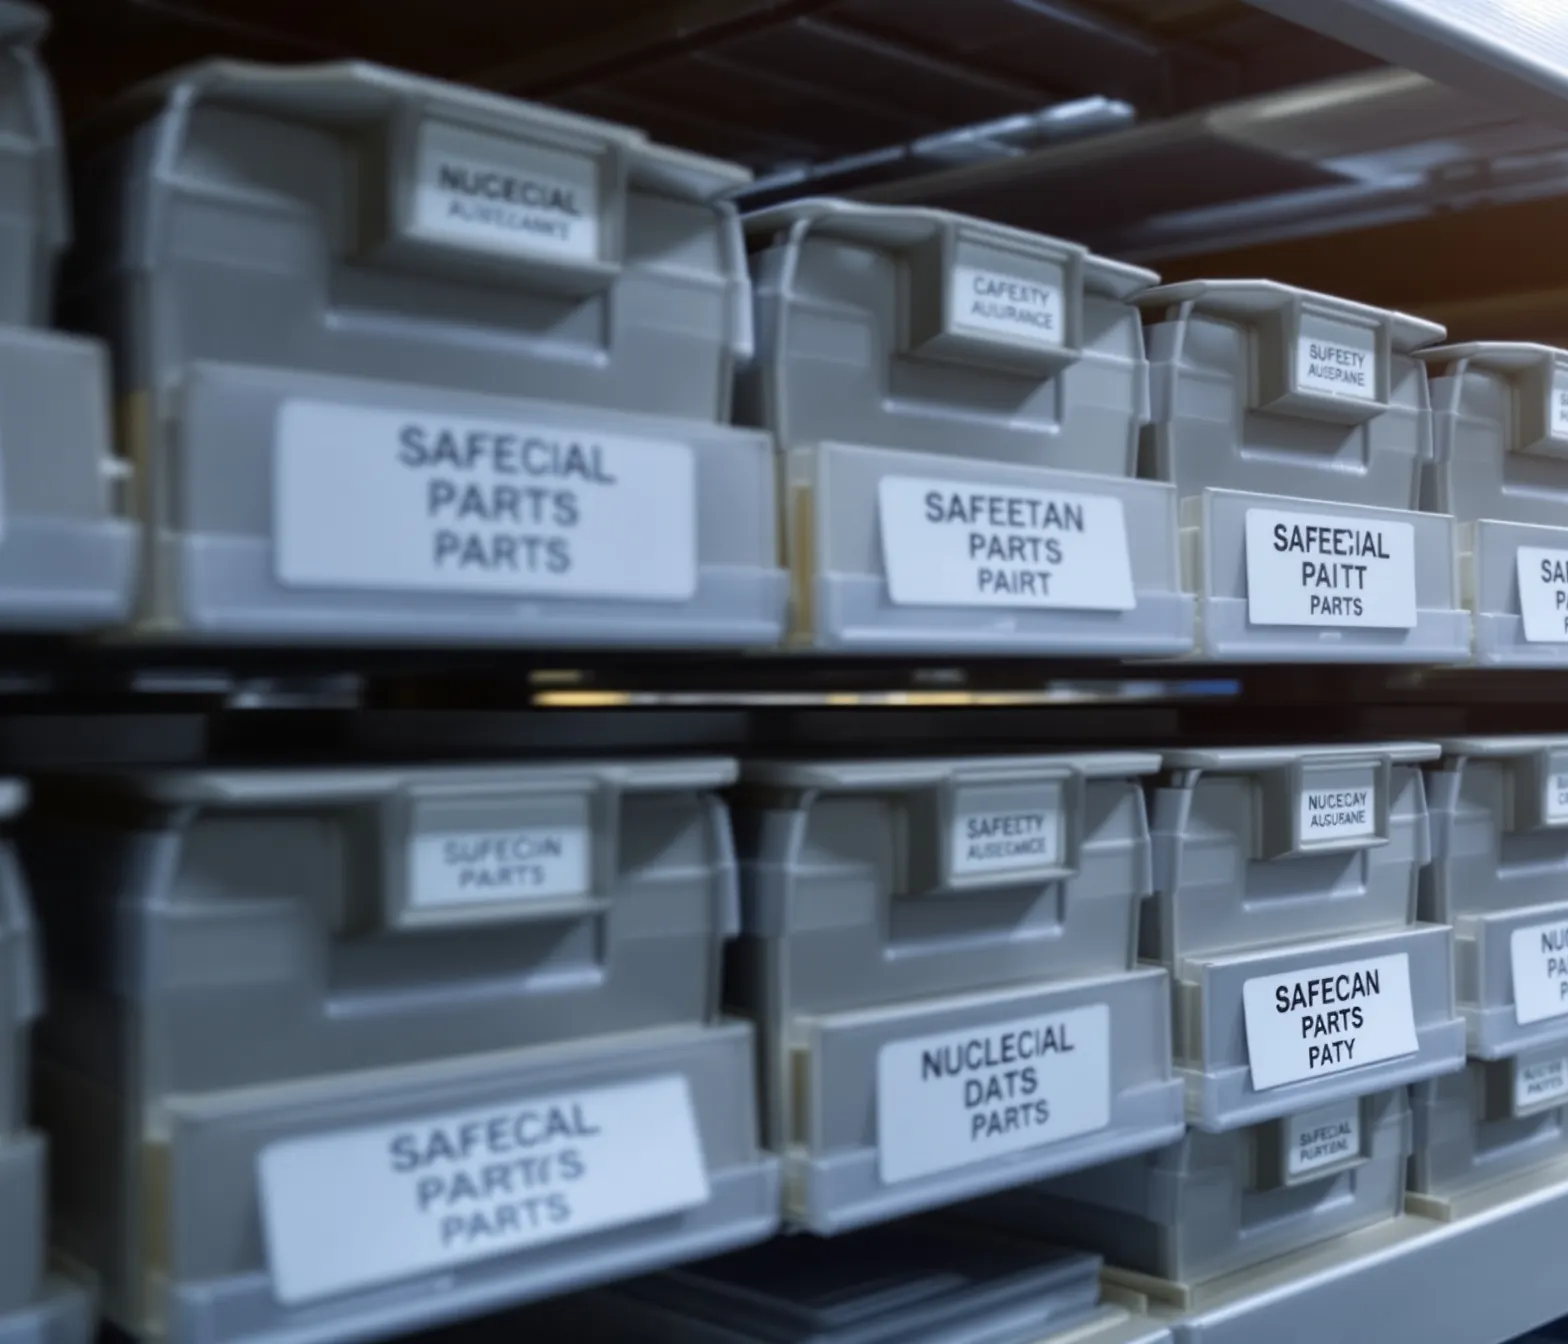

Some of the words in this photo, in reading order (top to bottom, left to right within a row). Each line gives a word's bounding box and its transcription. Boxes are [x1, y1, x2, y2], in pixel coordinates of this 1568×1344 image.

[396, 424, 618, 485] SAFECIAL
[427, 477, 581, 528] PARTS
[923, 490, 1085, 532] SAFEETAN
[431, 529, 573, 575] PARTS
[968, 532, 1064, 566] PARTS
[977, 567, 1053, 596] PAIRT
[1310, 594, 1364, 617] PARTS
[1275, 968, 1381, 1014] SAFECAN
[1301, 1006, 1365, 1039] PARTS
[920, 1022, 1075, 1082] NUCLECIAL
[1308, 1038, 1356, 1070] PATY
[964, 1066, 1038, 1109] DATS
[388, 1099, 602, 1174] SAFECAL
[970, 1098, 1051, 1142] PARTS
[438, 1192, 574, 1248] PARTS
